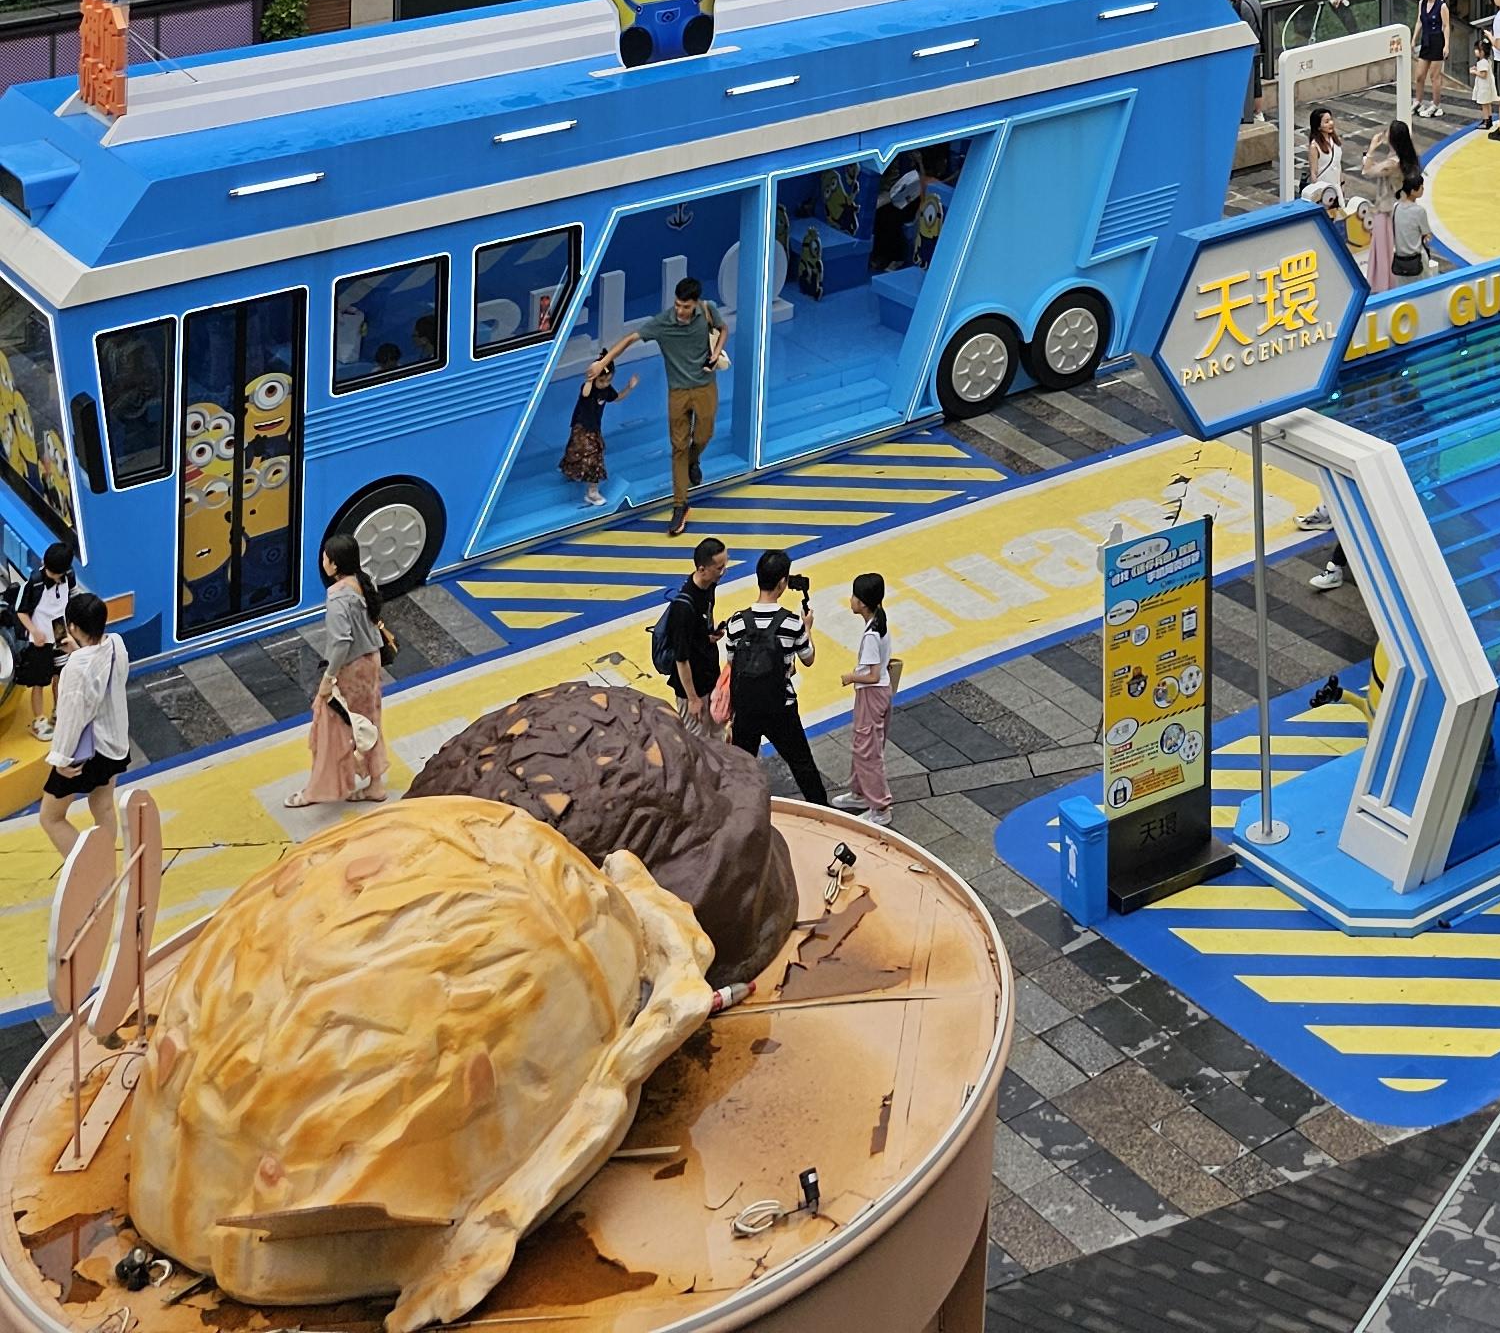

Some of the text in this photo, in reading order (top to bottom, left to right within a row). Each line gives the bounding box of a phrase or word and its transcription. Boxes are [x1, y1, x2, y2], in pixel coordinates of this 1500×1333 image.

[1194, 248, 1320, 361] 天環
[1181, 320, 1338, 387] PARC CENTRAL
